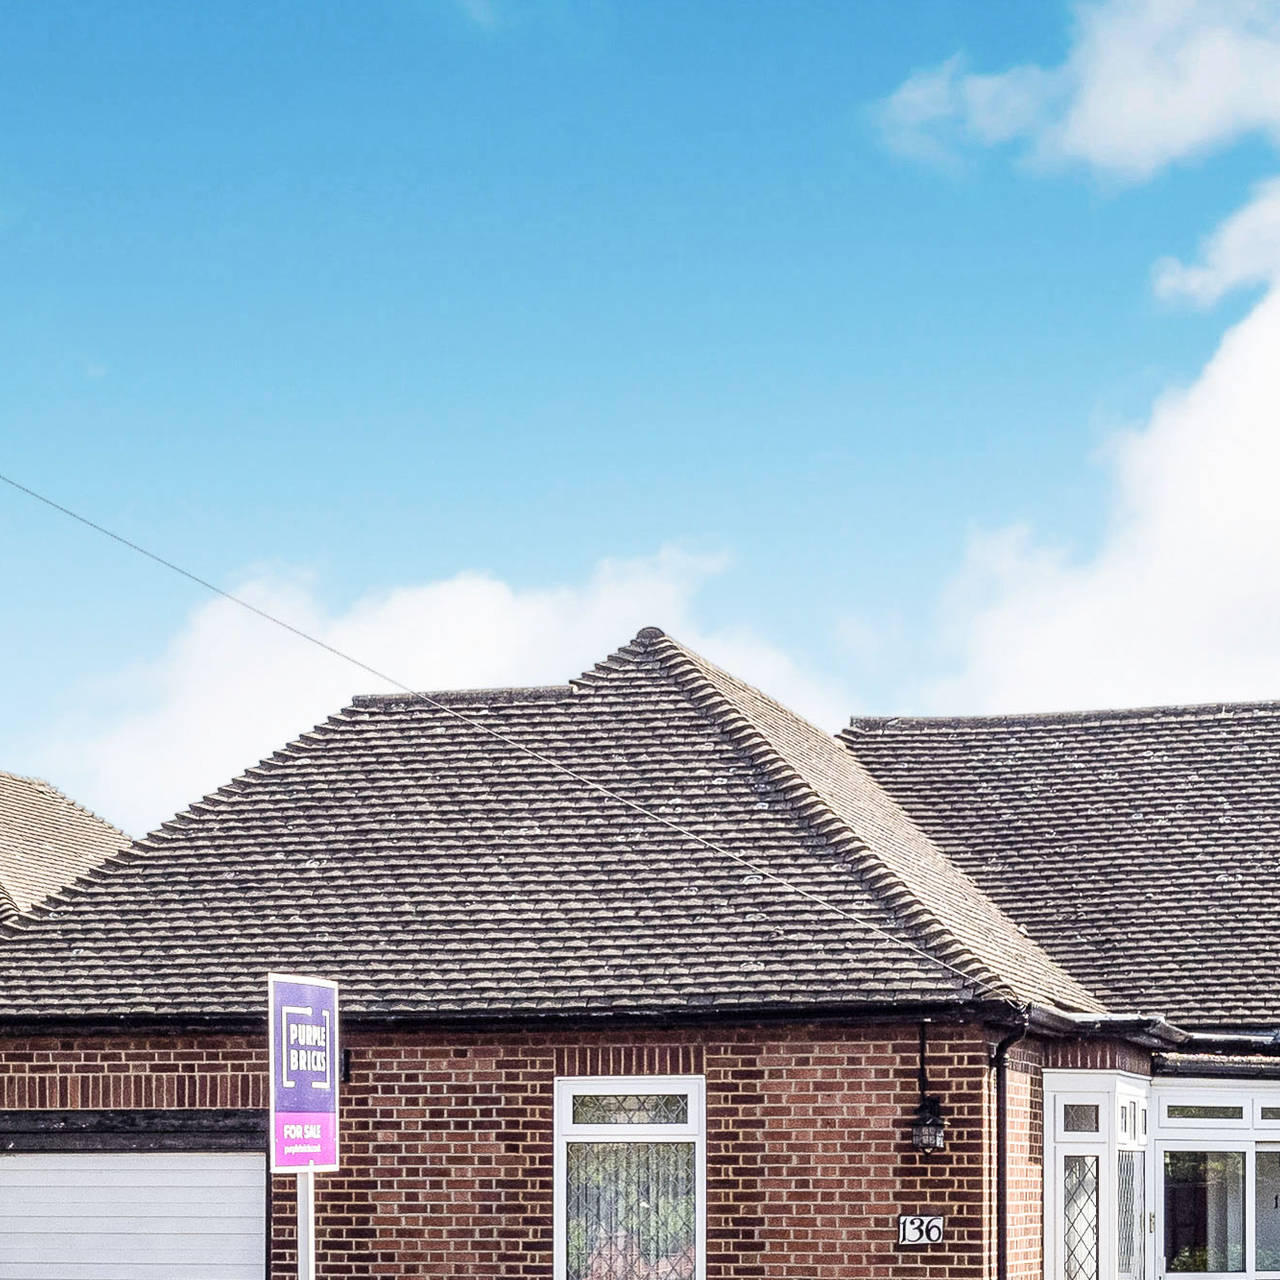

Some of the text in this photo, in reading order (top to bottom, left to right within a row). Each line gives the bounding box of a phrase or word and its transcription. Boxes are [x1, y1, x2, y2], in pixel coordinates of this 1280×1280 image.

[289, 1023, 326, 1047] PURPLE
[289, 1049, 326, 1072] BRICKS
[283, 1124, 321, 1139] FOR SALE
[900, 1217, 942, 1243] 136
